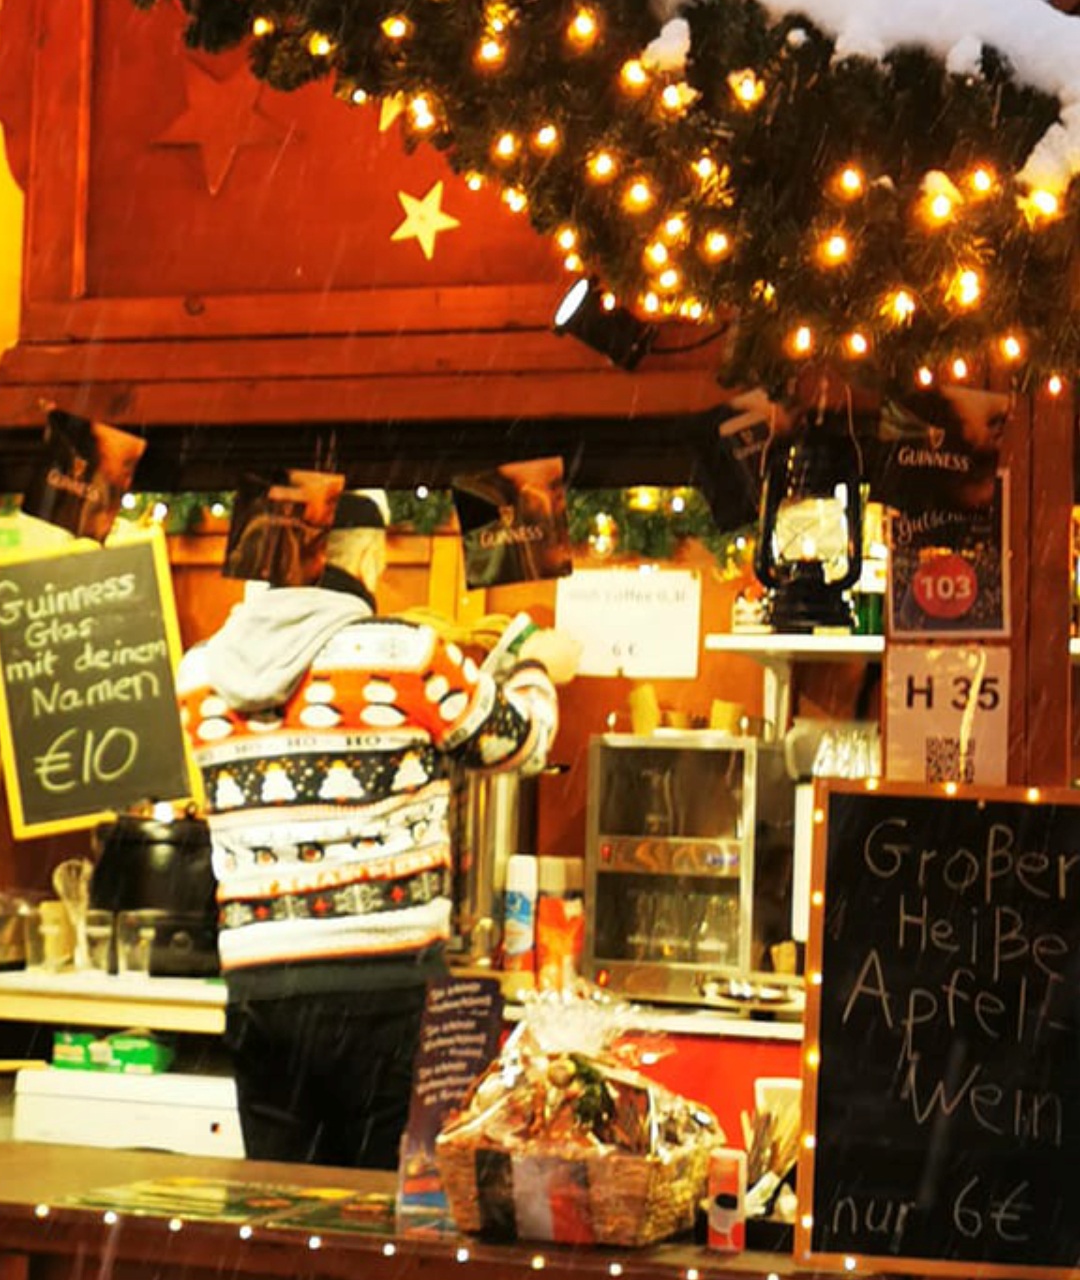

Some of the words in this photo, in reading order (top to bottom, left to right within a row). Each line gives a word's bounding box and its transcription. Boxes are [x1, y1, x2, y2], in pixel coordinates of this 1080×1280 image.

[898, 445, 970, 472] GUINNESS
[921, 574, 972, 600] 103
[25, 617, 95, 648] Glas
[6, 651, 58, 683] mit
[74, 639, 168, 672] deinem
[31, 670, 160, 717] Namen
[906, 674, 933, 710] H
[951, 675, 1000, 712] 35
[33, 726, 139, 792] €10
[863, 817, 1080, 903] Großer
[898, 893, 1069, 983] Heiße
[908, 1062, 1062, 1148] Wein
[833, 1195, 917, 1235] nur
[953, 1174, 1034, 1242] 6€
